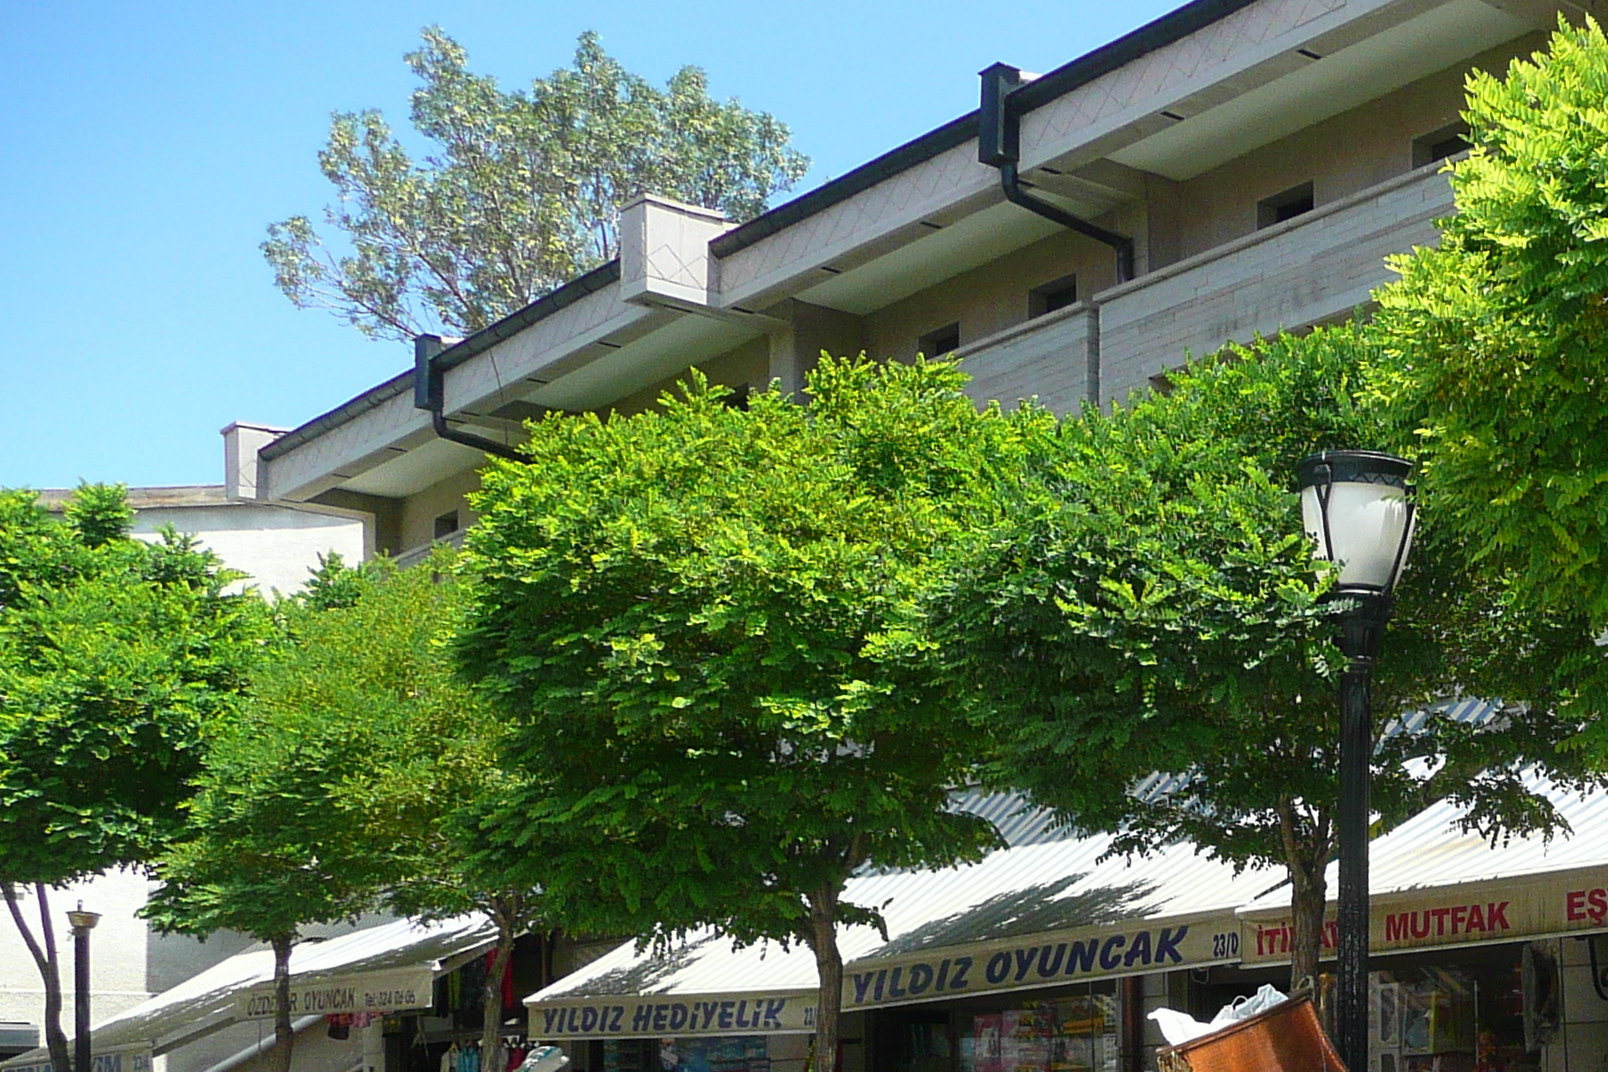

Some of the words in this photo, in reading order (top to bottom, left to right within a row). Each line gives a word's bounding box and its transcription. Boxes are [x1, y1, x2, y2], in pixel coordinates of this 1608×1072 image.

[1385, 901, 1510, 942] MUTFAK
[853, 955, 974, 1003] YILDIZ
[985, 925, 1188, 985] OYUNCAK
[304, 987, 355, 1011] OYUNCAK
[543, 1005, 624, 1034] YILDIZ
